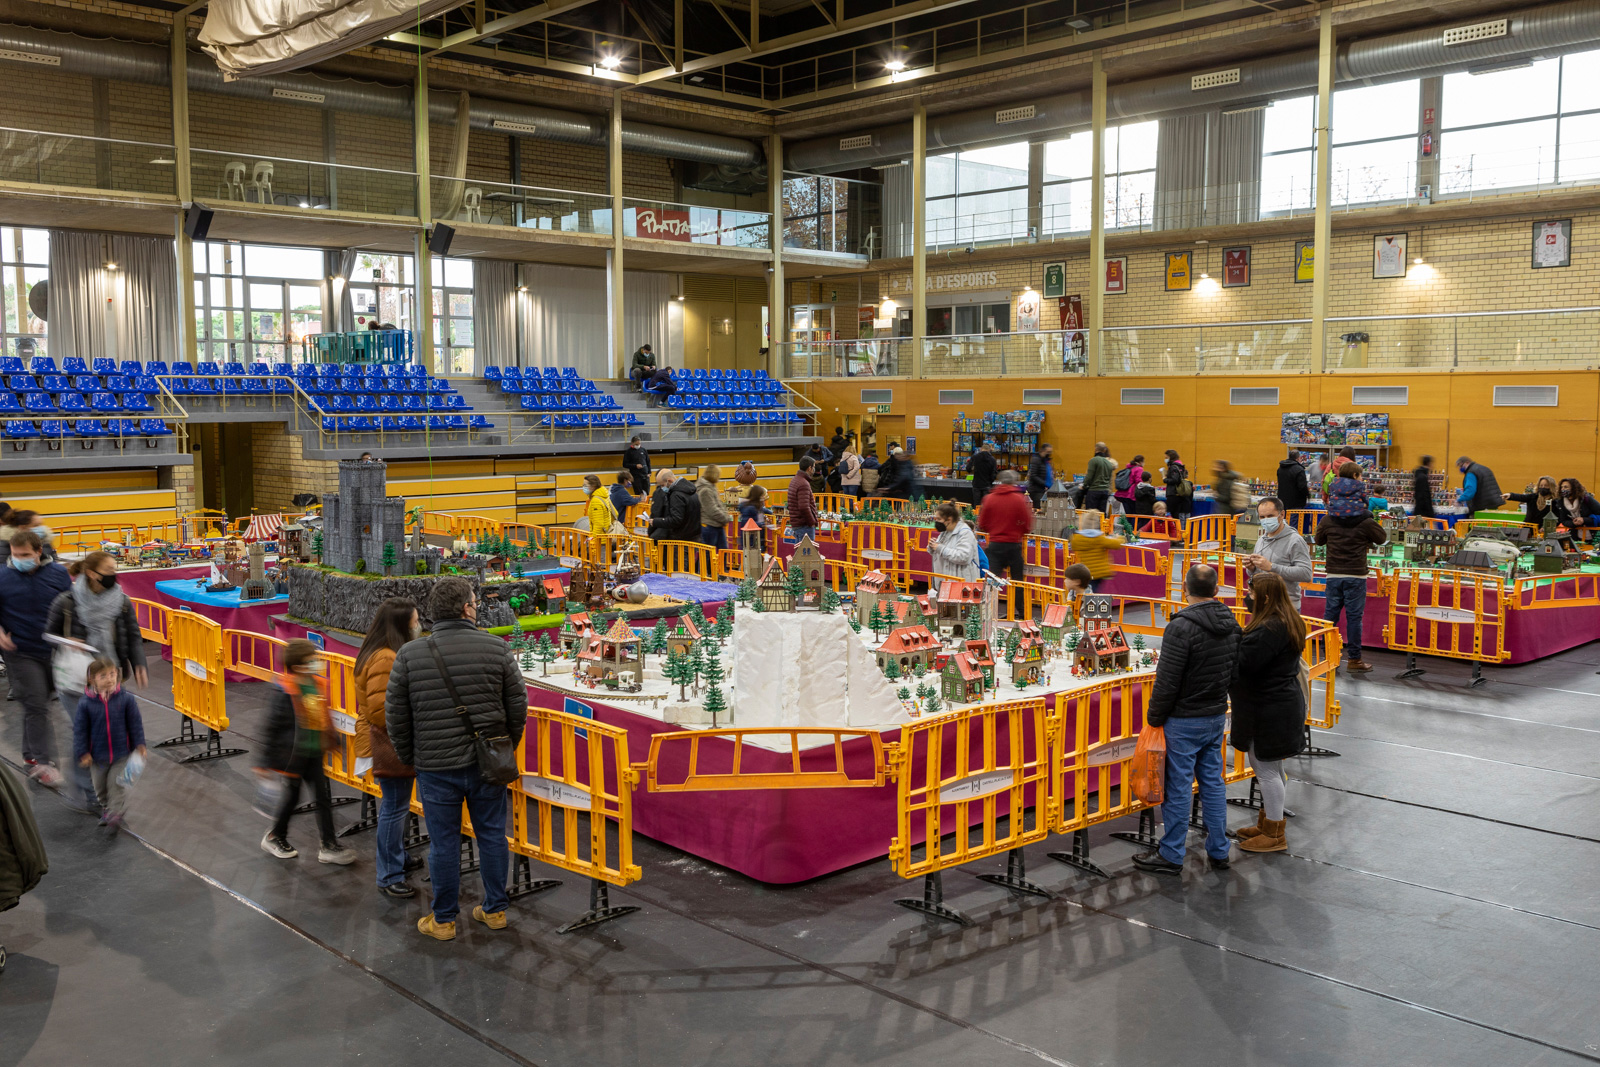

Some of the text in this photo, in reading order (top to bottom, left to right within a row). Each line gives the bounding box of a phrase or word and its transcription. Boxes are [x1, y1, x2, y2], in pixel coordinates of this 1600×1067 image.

[1111, 267, 1117, 277] 5
[905, 270, 997, 291] ÀA D'ESPORTS
[1051, 275, 1057, 285] 8
